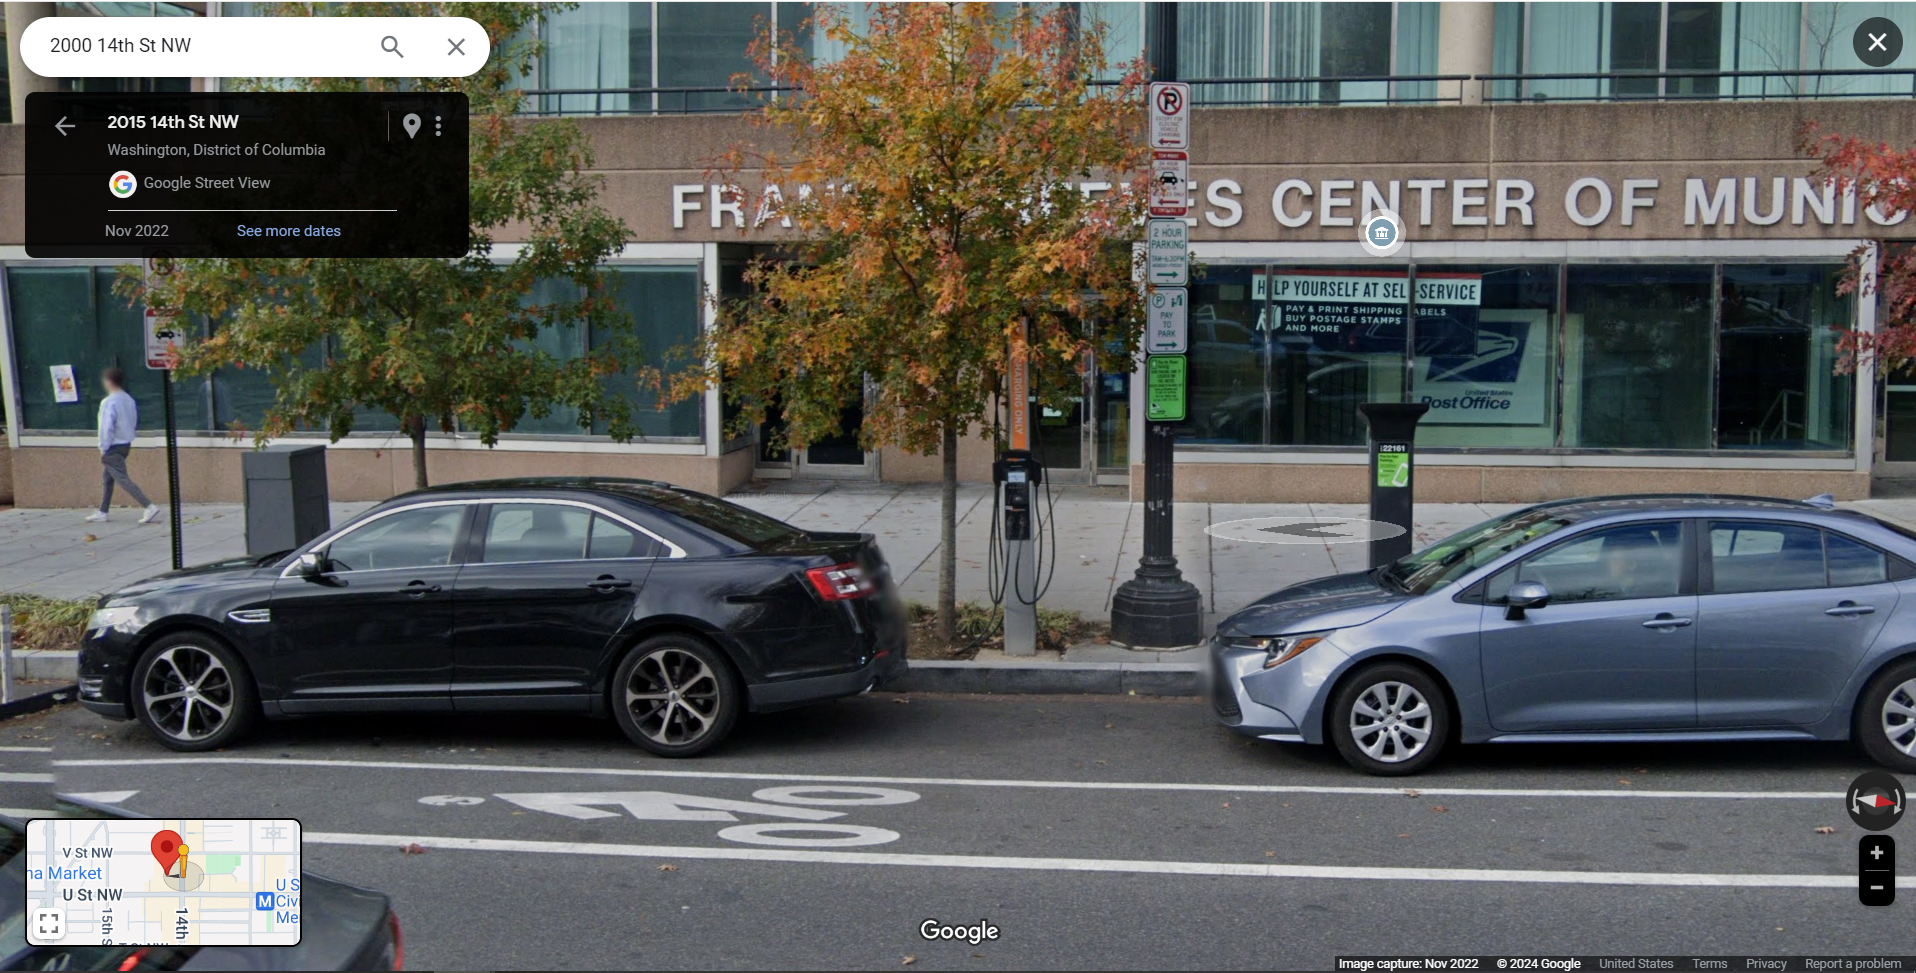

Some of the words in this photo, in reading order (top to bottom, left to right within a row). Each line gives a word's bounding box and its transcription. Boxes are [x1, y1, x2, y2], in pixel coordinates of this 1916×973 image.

[1271, 178, 1536, 229] CENTER
[1564, 177, 1659, 227] OF
[1154, 228, 1159, 237] 2
[1162, 228, 1182, 237] HOUR
[1151, 240, 1184, 249] PARKING
[1257, 280, 1289, 296] HLP
[1293, 281, 1359, 298] YOURSELF
[1363, 282, 1379, 298] AT
[1160, 311, 1173, 319] PAY
[1285, 305, 1304, 313] PAY
[1308, 305, 1315, 313] &
[1319, 306, 1349, 314] PRINT
[1353, 306, 1403, 315] SHIPPING
[1413, 307, 1447, 316] ABELS
[1285, 315, 1306, 323] BUY
[1309, 315, 1357, 324] POSTAGE
[1361, 316, 1401, 325] STAMPS
[1285, 324, 1307, 332] AND
[1311, 325, 1340, 333] MORE
[1157, 330, 1176, 338] PARK
[1460, 396, 1511, 410] Office
[1014, 409, 1023, 434] ONLY
